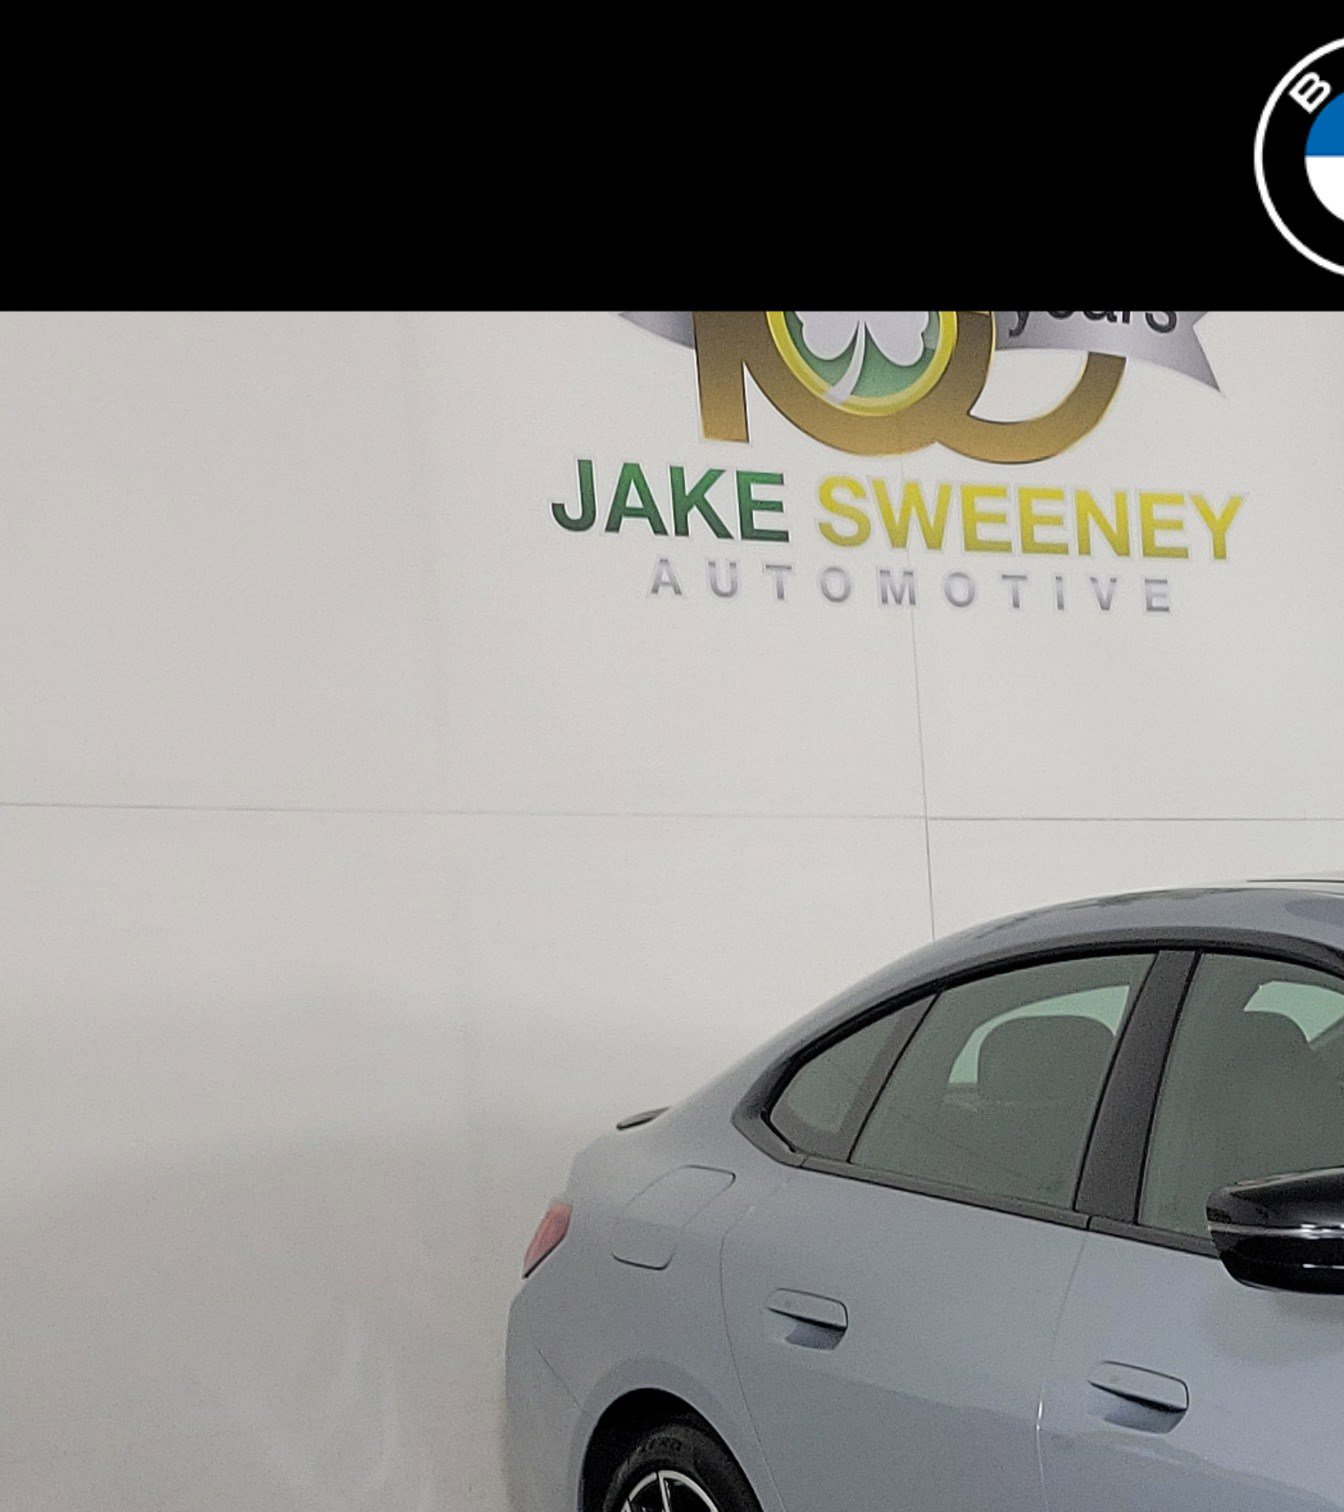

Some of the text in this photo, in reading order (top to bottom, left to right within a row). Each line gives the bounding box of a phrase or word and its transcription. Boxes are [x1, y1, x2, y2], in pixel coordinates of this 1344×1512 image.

[551, 459, 1247, 561] JAKE SWEENEY
[650, 558, 1171, 612] AUTOMOTIVE
